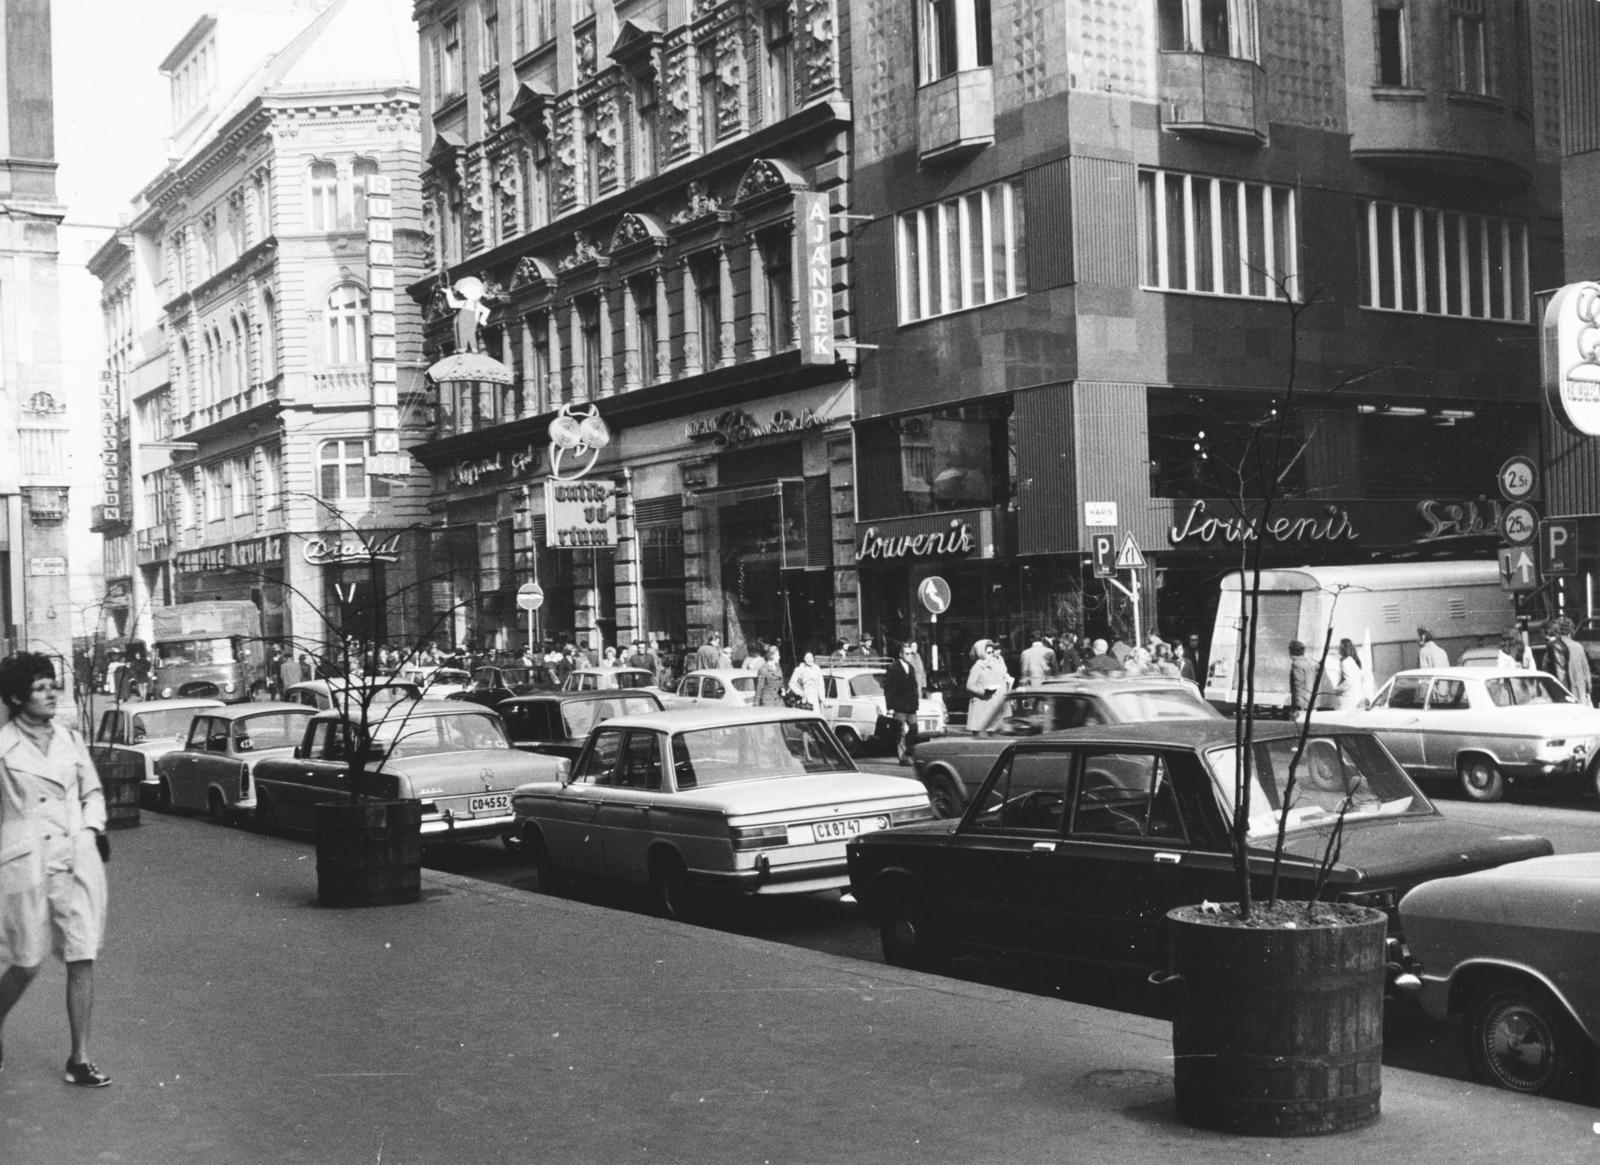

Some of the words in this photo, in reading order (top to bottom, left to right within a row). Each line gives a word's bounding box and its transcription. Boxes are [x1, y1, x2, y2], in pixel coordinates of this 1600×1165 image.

[1172, 500, 1360, 543] Souvenir
[231, 536, 281, 567] ÁRUHÁZ
[856, 519, 975, 560] Souvenir
[1098, 538, 1110, 565] P
[1550, 526, 1568, 559] P
